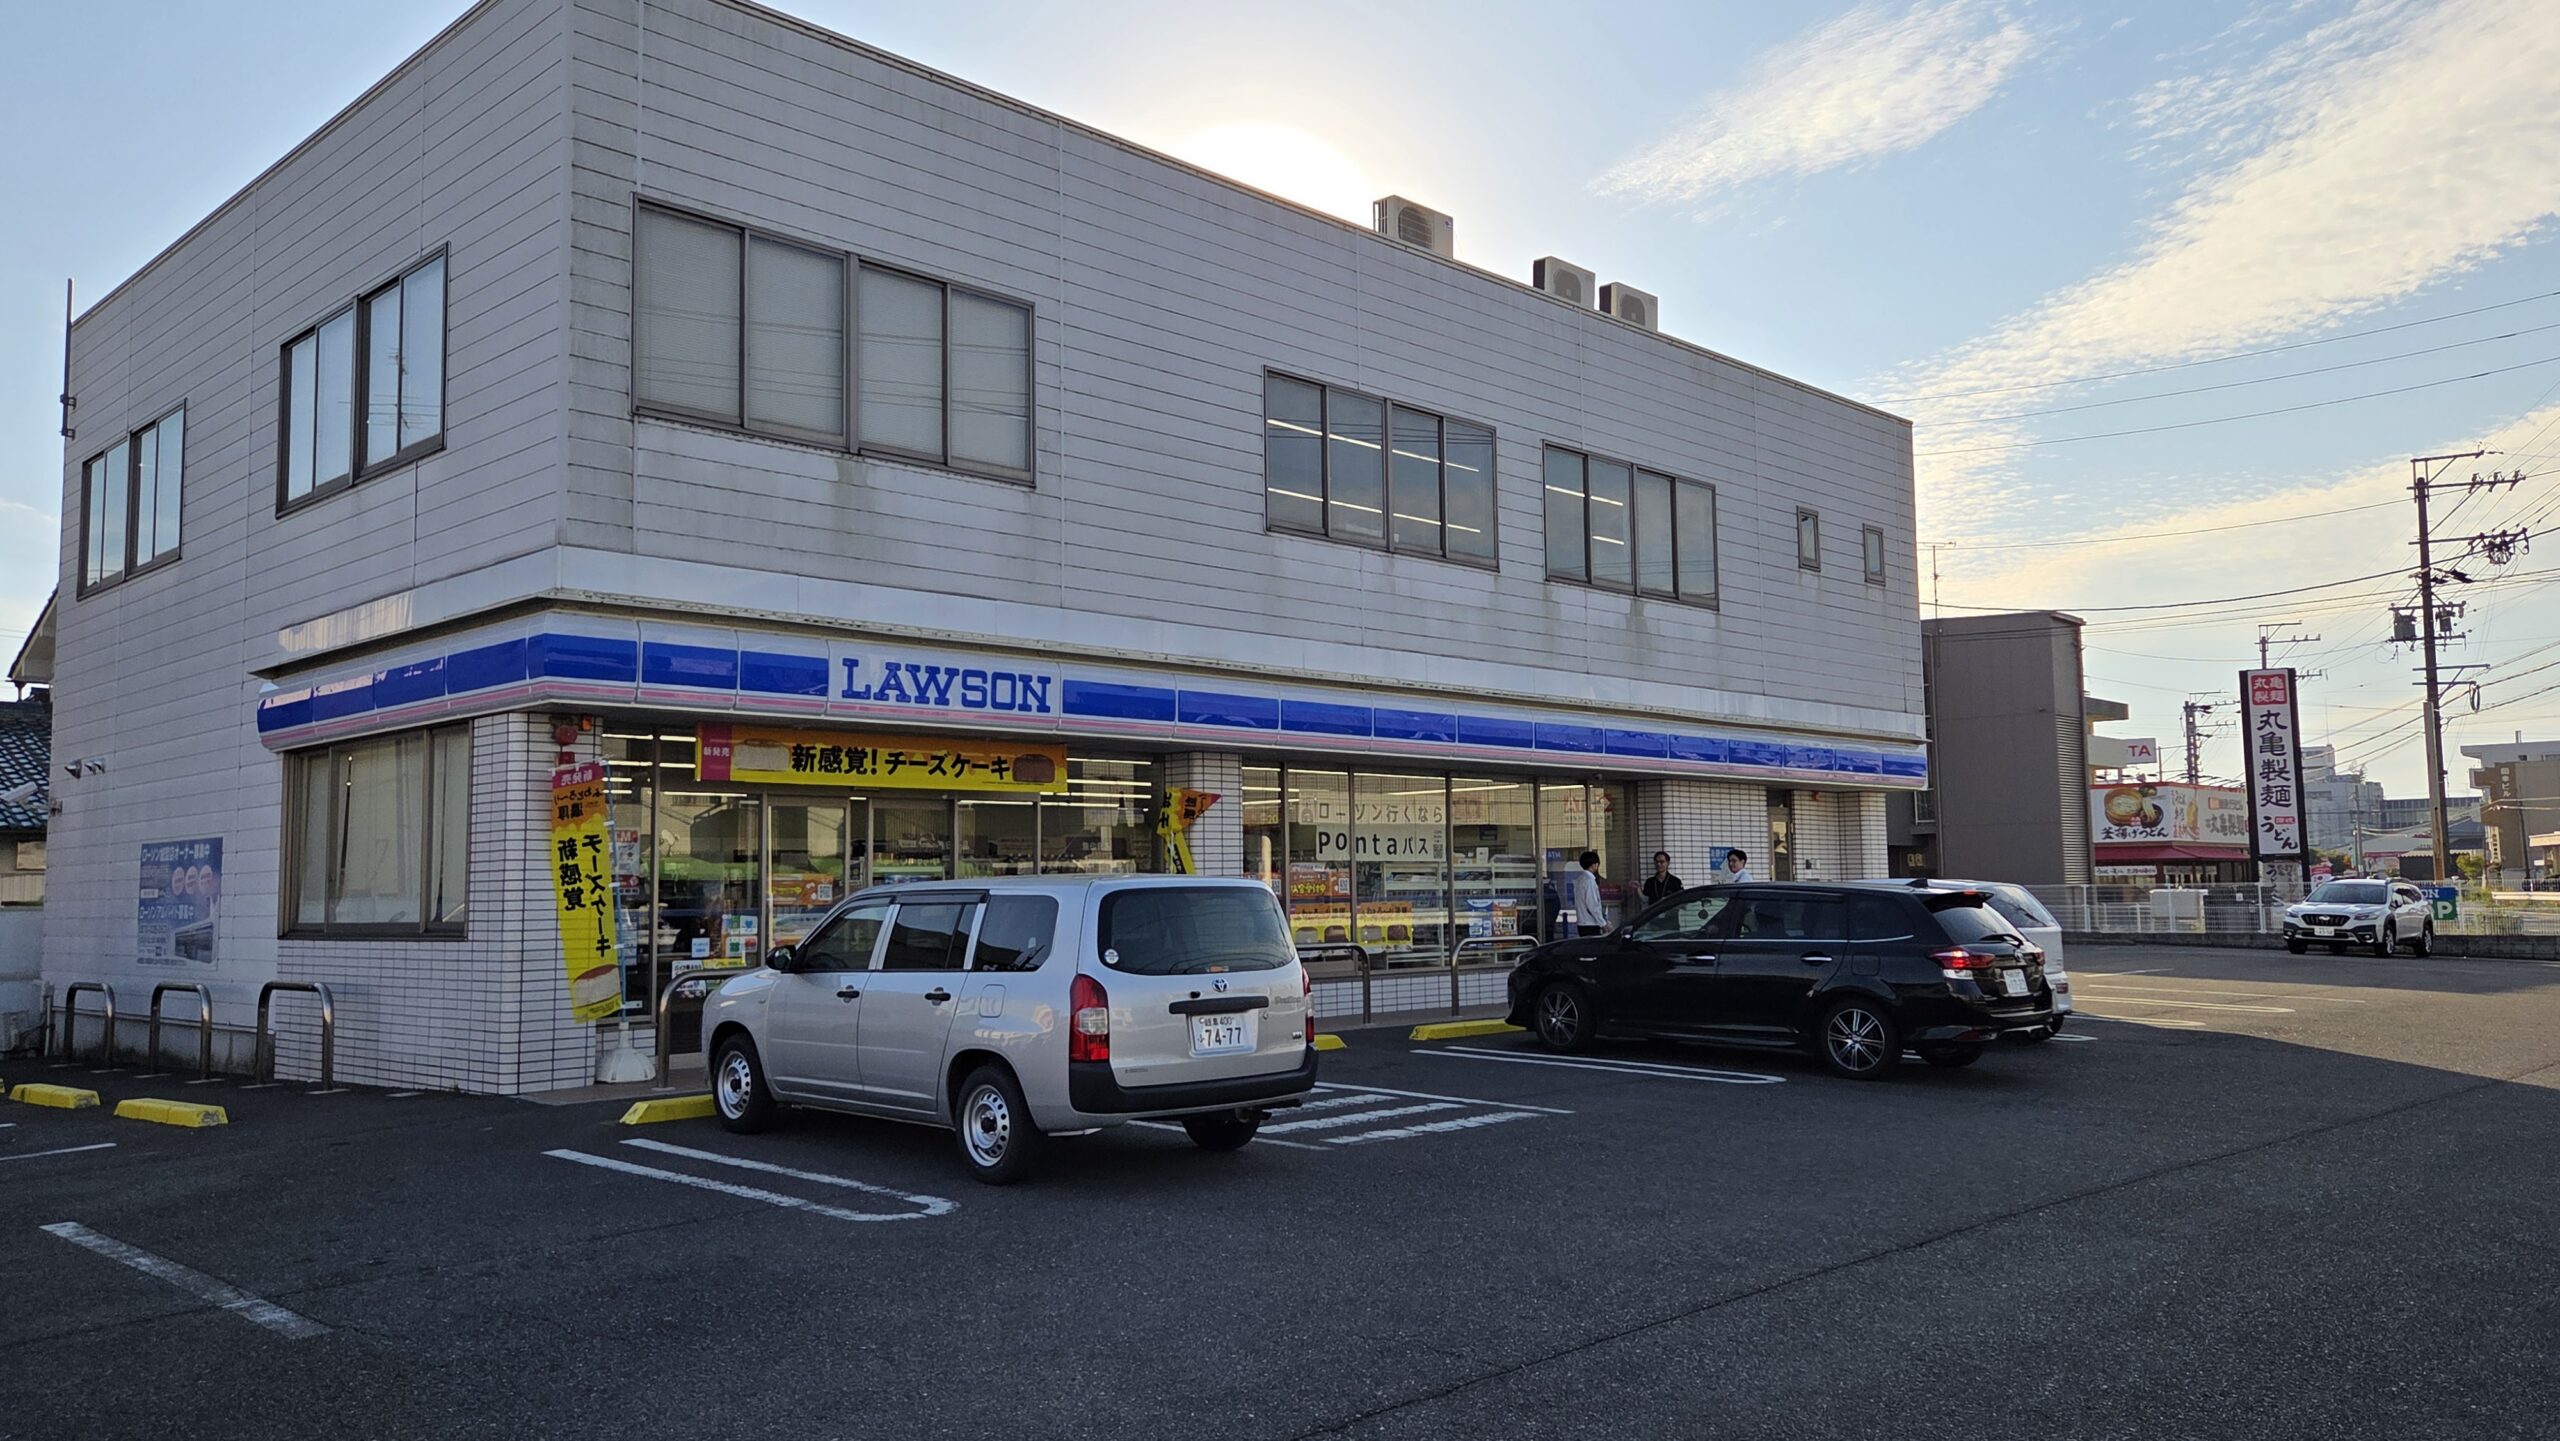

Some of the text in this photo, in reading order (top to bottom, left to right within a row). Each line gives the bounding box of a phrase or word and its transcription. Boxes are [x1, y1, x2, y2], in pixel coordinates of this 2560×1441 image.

[842, 658, 1051, 713] LAWSON
[2253, 677, 2284, 689] 丸亀
[2254, 690, 2286, 703] 製麺
[2128, 745, 2151, 757] TA
[2257, 709, 2292, 808] 丸亀製麺
[1319, 802, 1443, 823] ローソン行くなら
[2260, 815, 2299, 850] うどん
[2436, 901, 2453, 919] P
[1219, 1016, 1233, 1026] 400
[1204, 1027, 1242, 1047] 74-77
